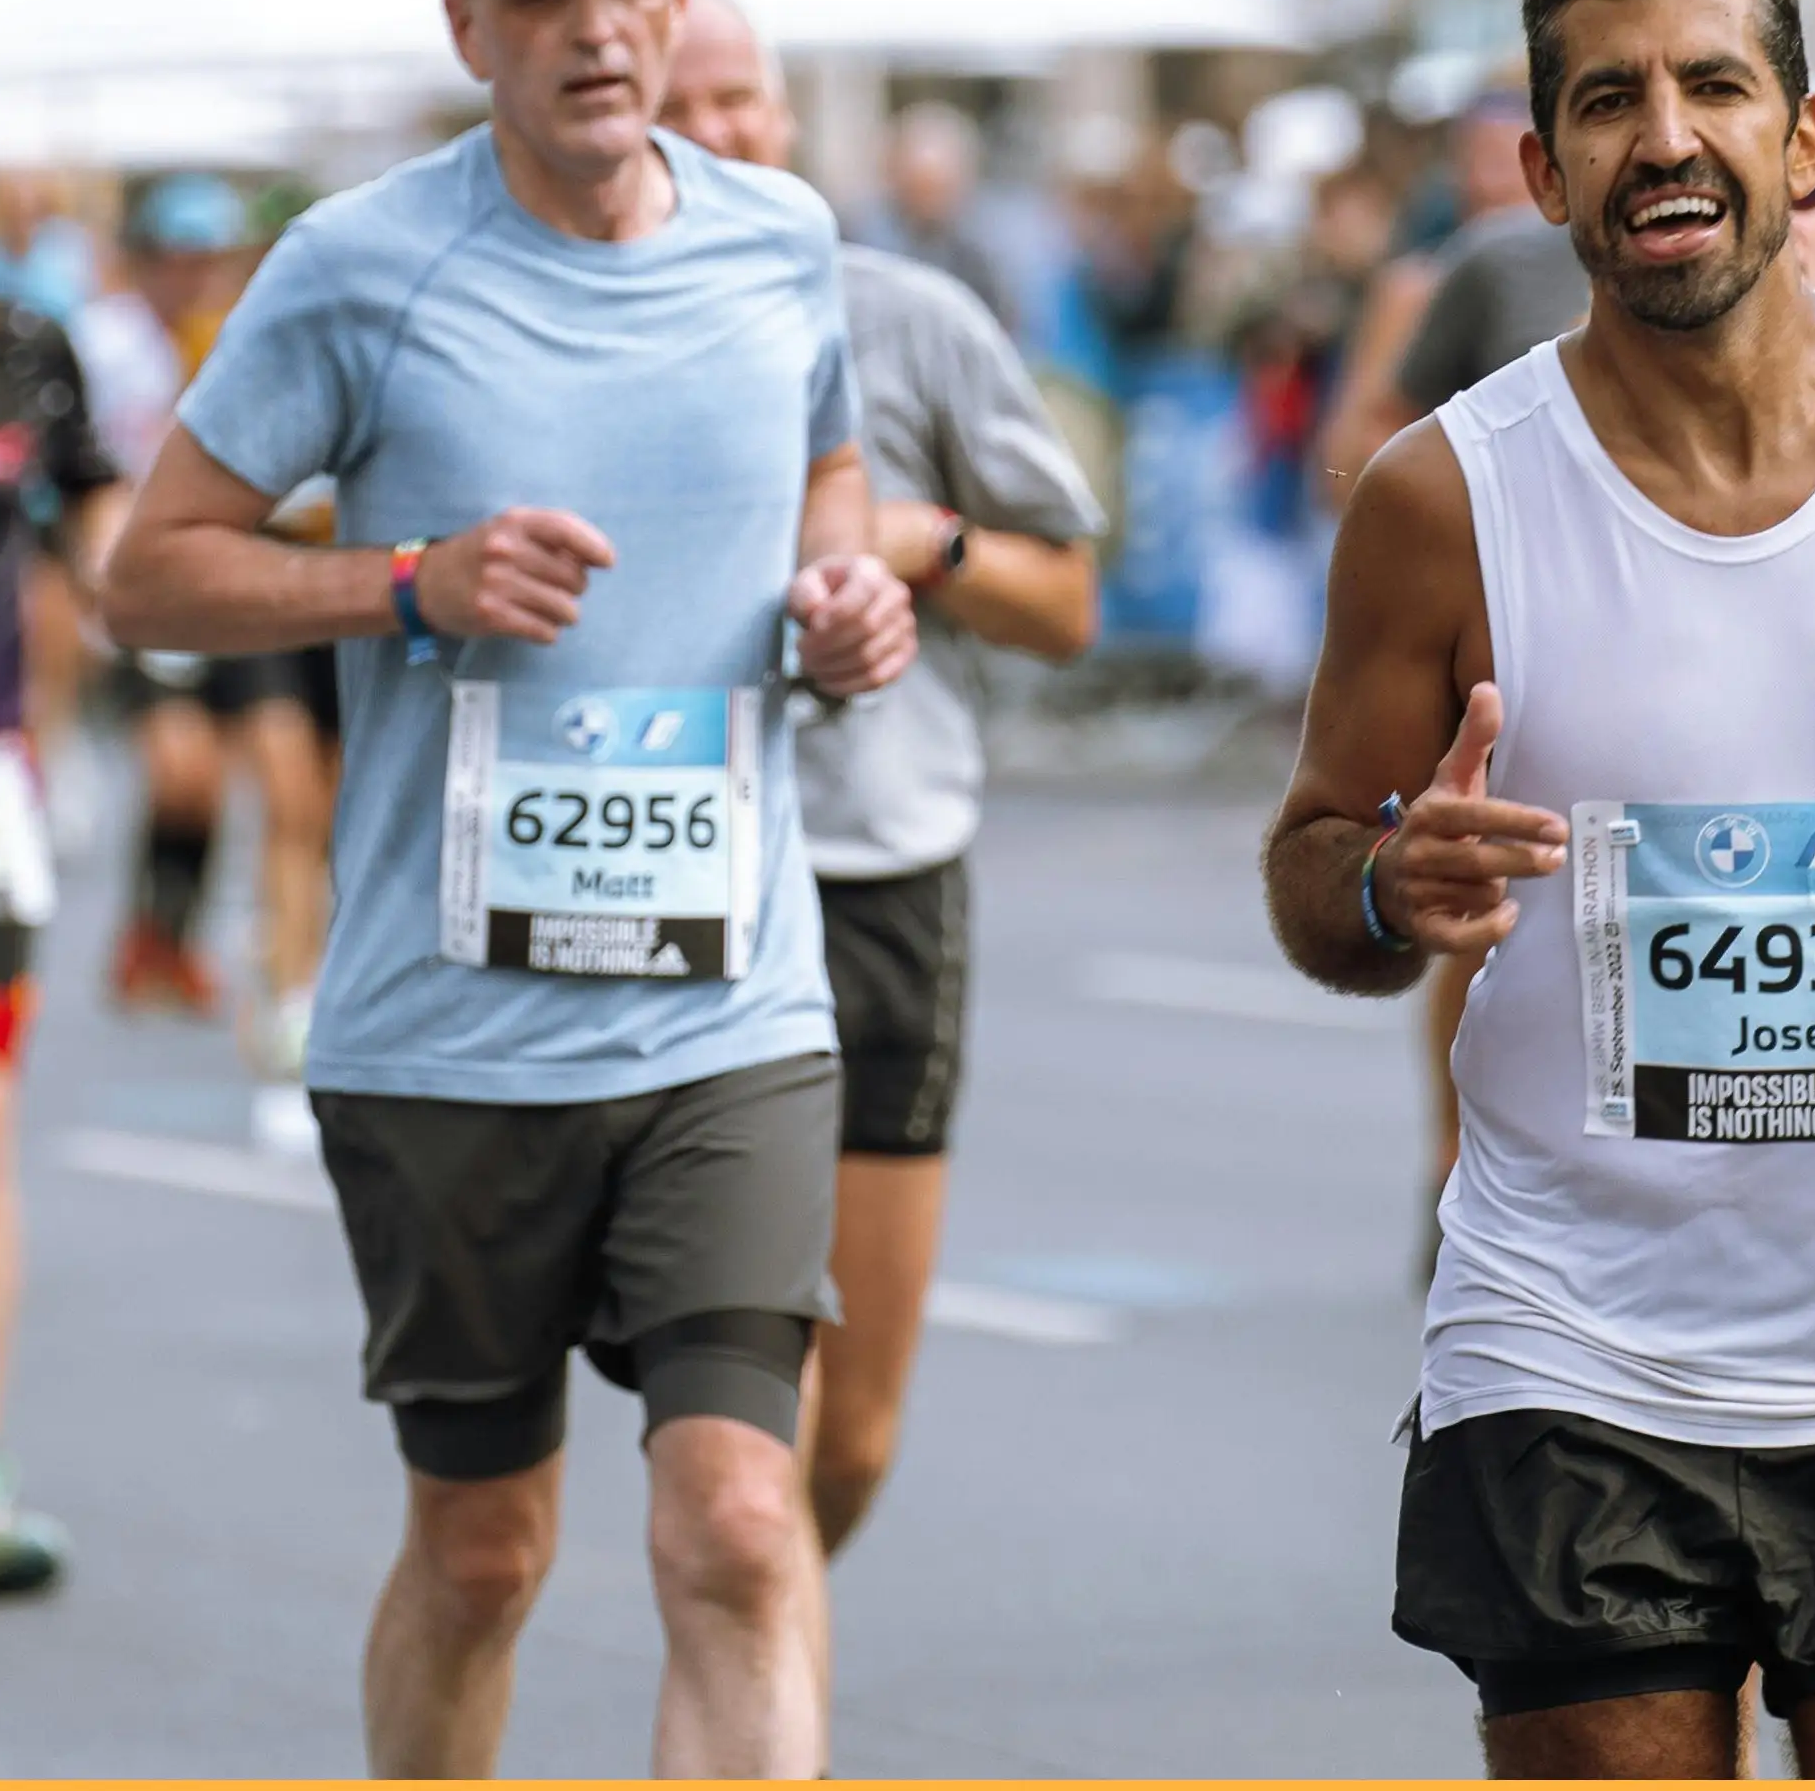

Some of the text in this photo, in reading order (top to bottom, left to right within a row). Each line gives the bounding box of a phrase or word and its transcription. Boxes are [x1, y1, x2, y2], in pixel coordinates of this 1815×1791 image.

[506, 789, 718, 849] 62956
[571, 867, 656, 899] Matt
[1609, 983, 1626, 1072] September
[1687, 1105, 1713, 1138] IS
